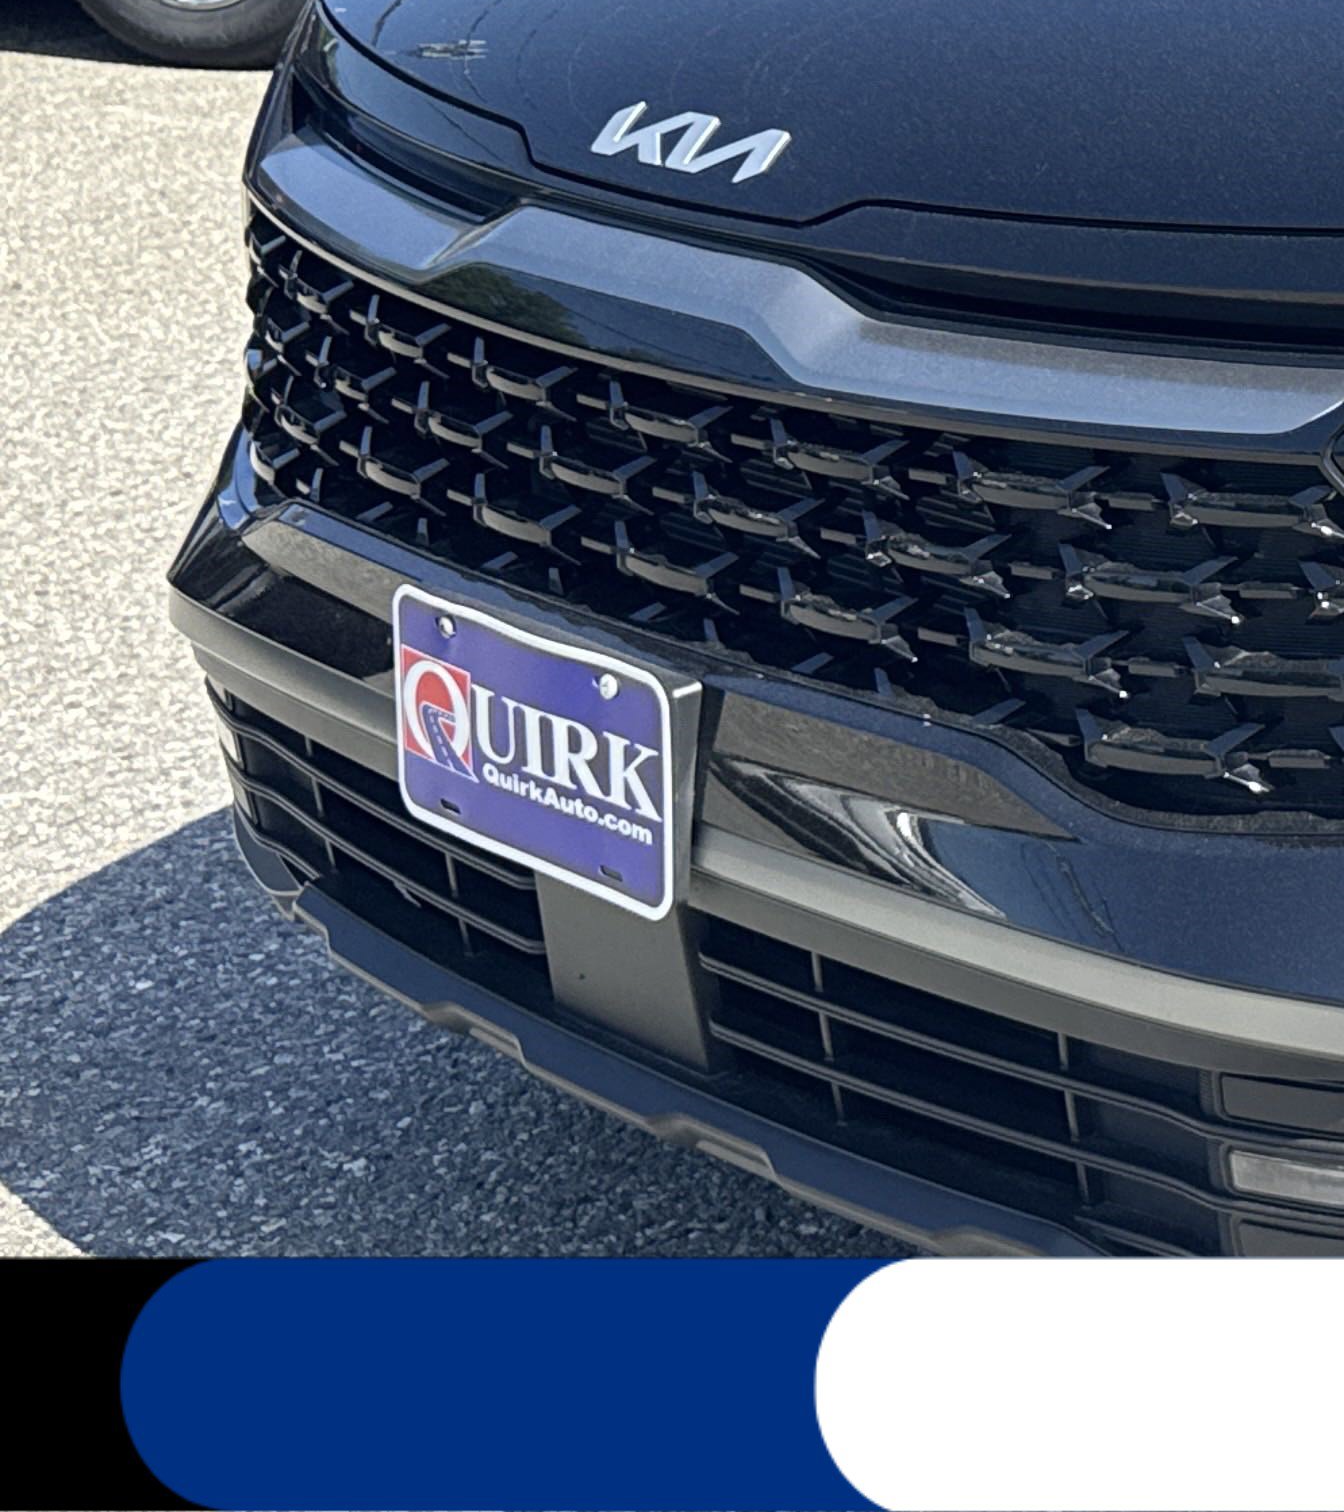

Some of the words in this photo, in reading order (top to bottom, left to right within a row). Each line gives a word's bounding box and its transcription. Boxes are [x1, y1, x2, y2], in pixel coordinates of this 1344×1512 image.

[590, 99, 793, 185] KIA
[402, 658, 663, 823] QUIRK
[481, 760, 654, 846] QuirkAuto.com
